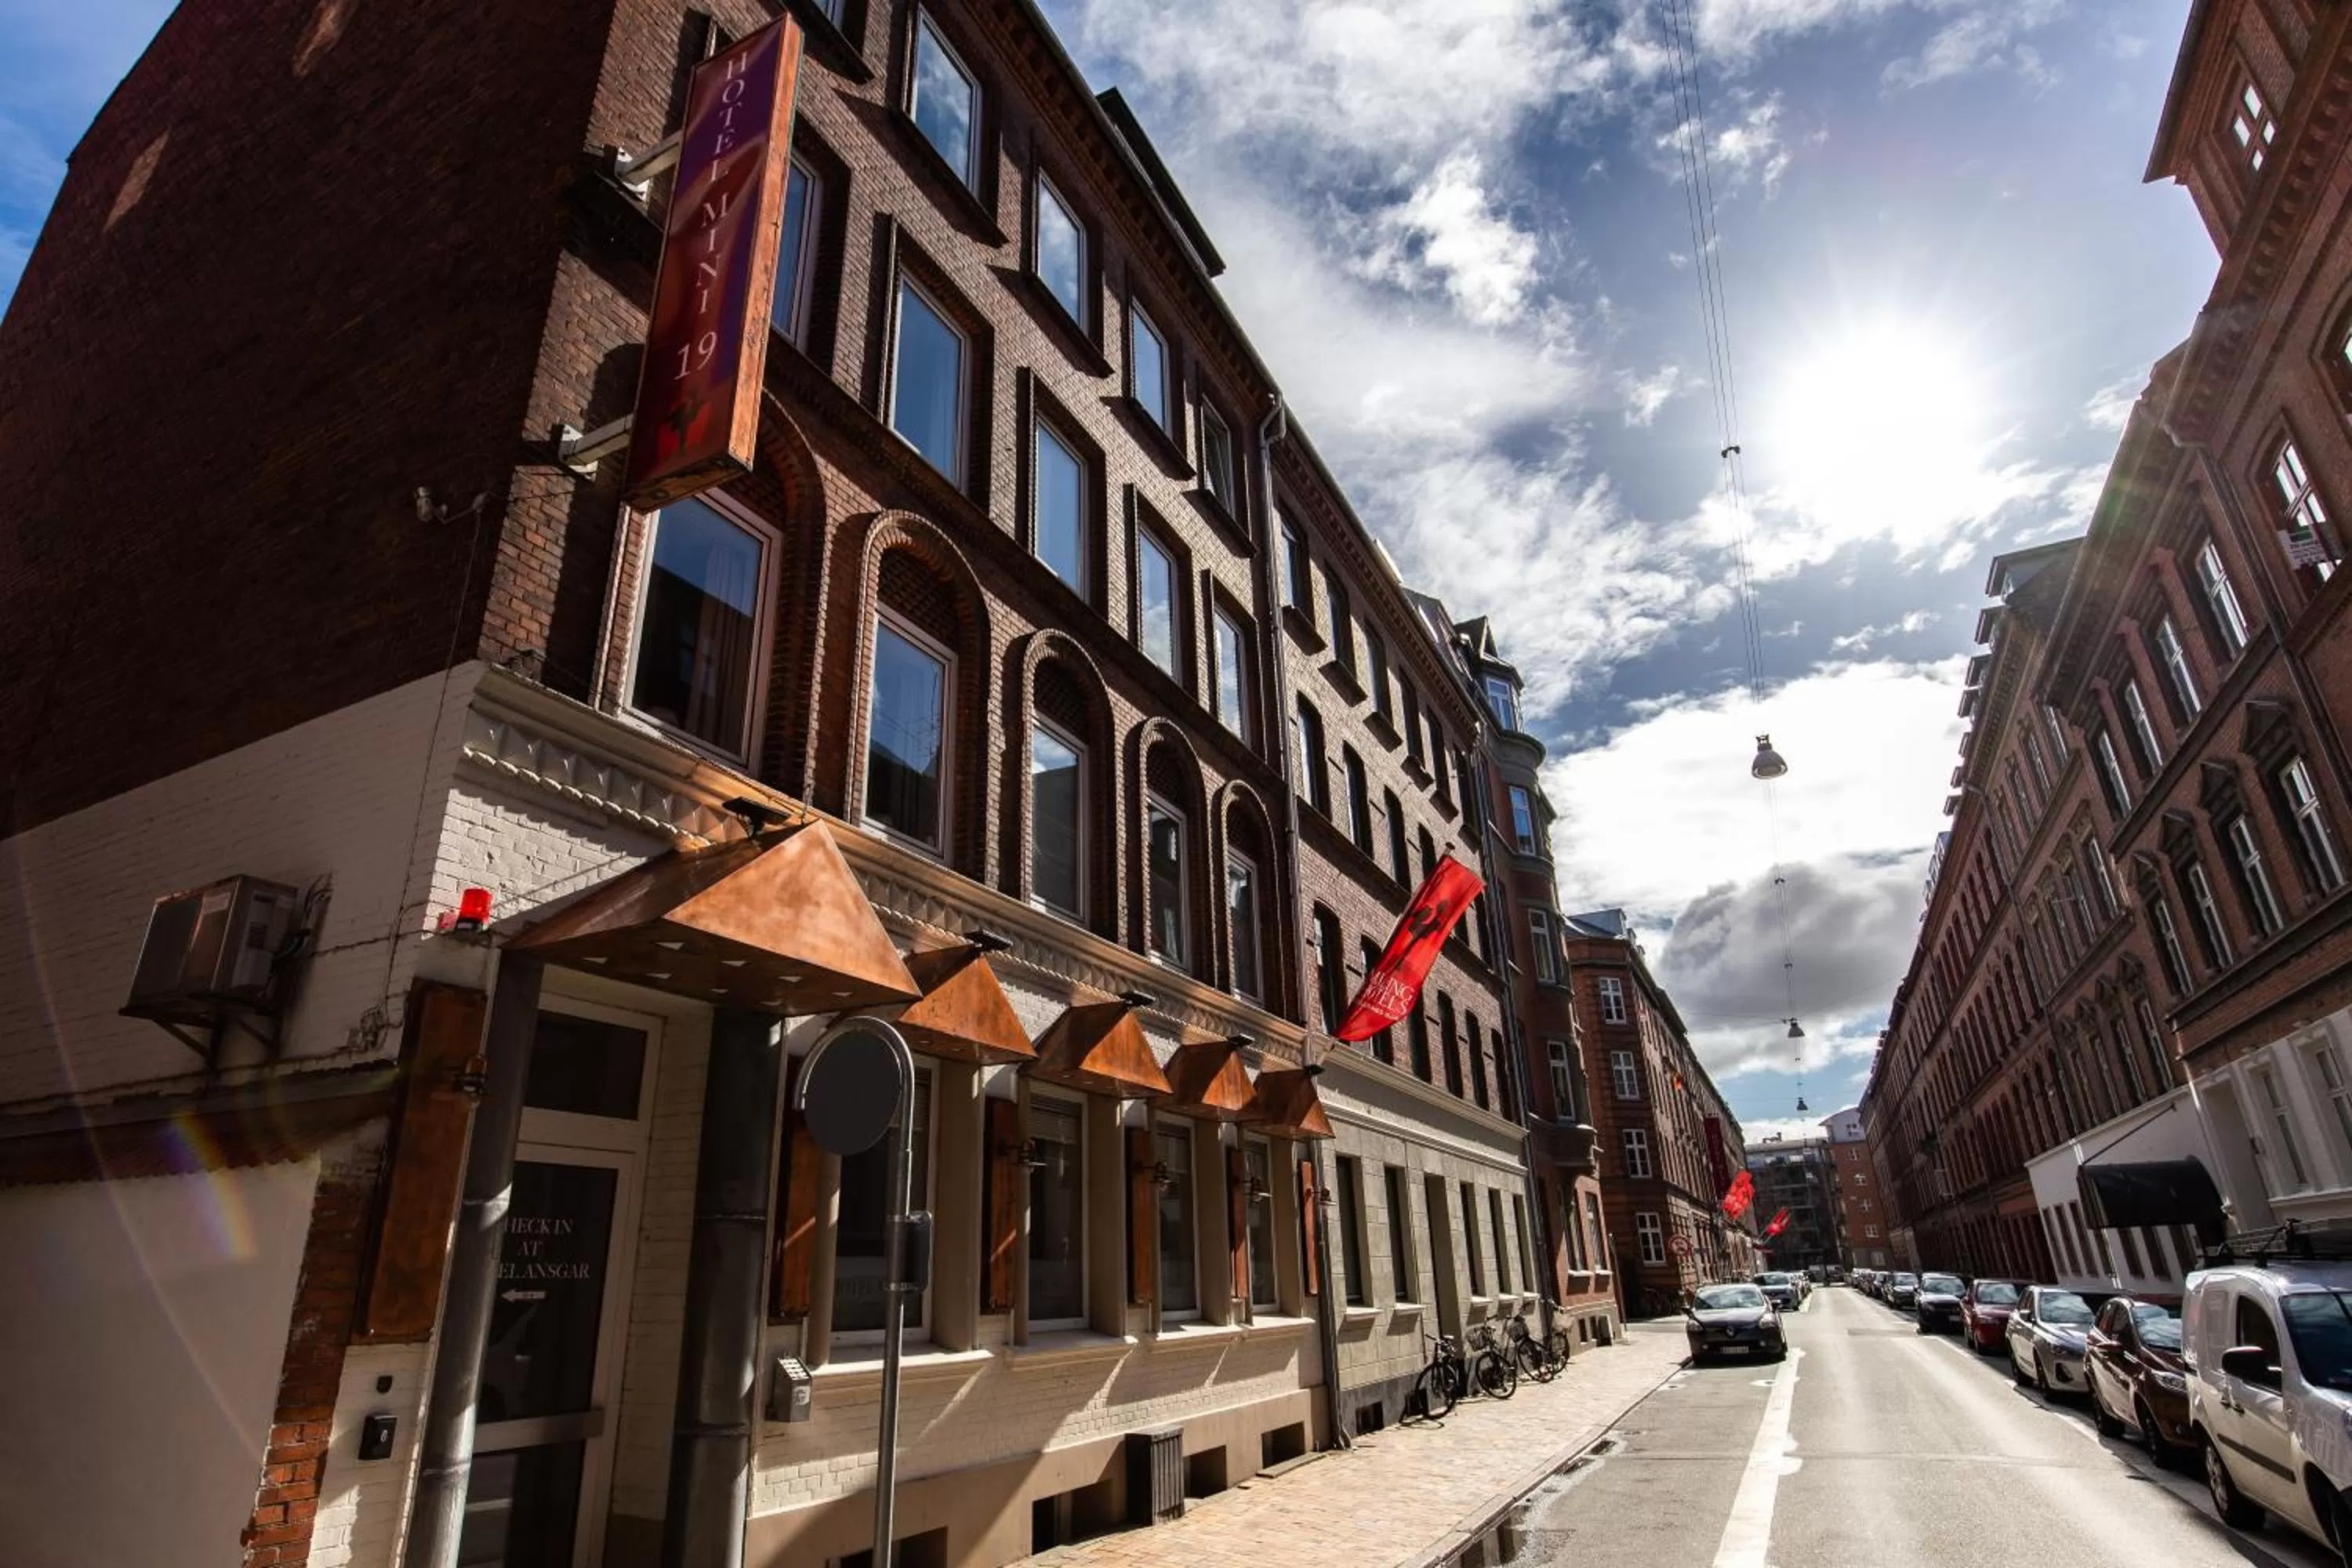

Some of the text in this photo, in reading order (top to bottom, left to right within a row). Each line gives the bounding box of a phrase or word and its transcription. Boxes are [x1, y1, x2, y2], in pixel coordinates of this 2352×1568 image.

[674, 50, 747, 381] HOTEL MINI 19
[503, 1217, 575, 1236] HECK IN
[517, 1240, 544, 1257] AT
[498, 1263, 590, 1280] EL ANSGAR
